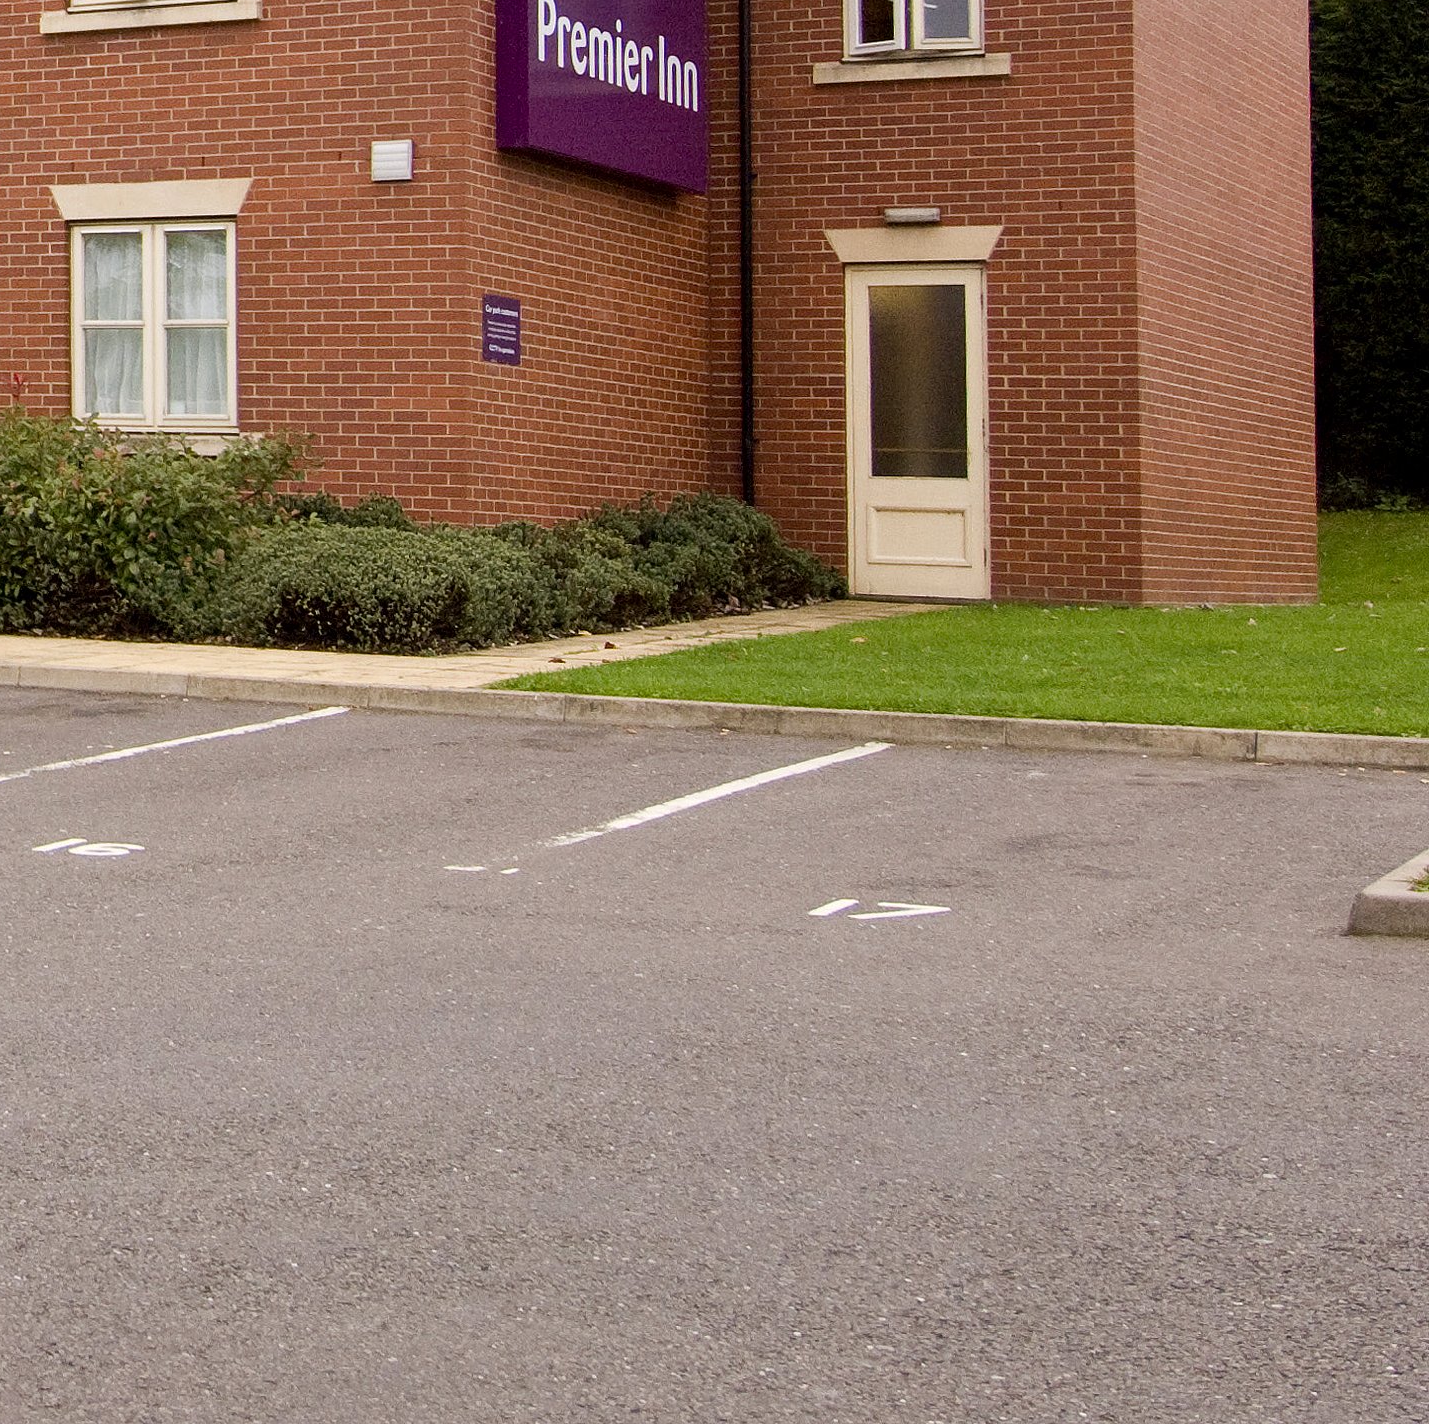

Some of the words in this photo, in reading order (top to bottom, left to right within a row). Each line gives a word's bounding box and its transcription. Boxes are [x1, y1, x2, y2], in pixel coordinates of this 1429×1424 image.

[658, 34, 699, 112] Inn
[31, 837, 146, 857] 16
[807, 898, 952, 920] 17
